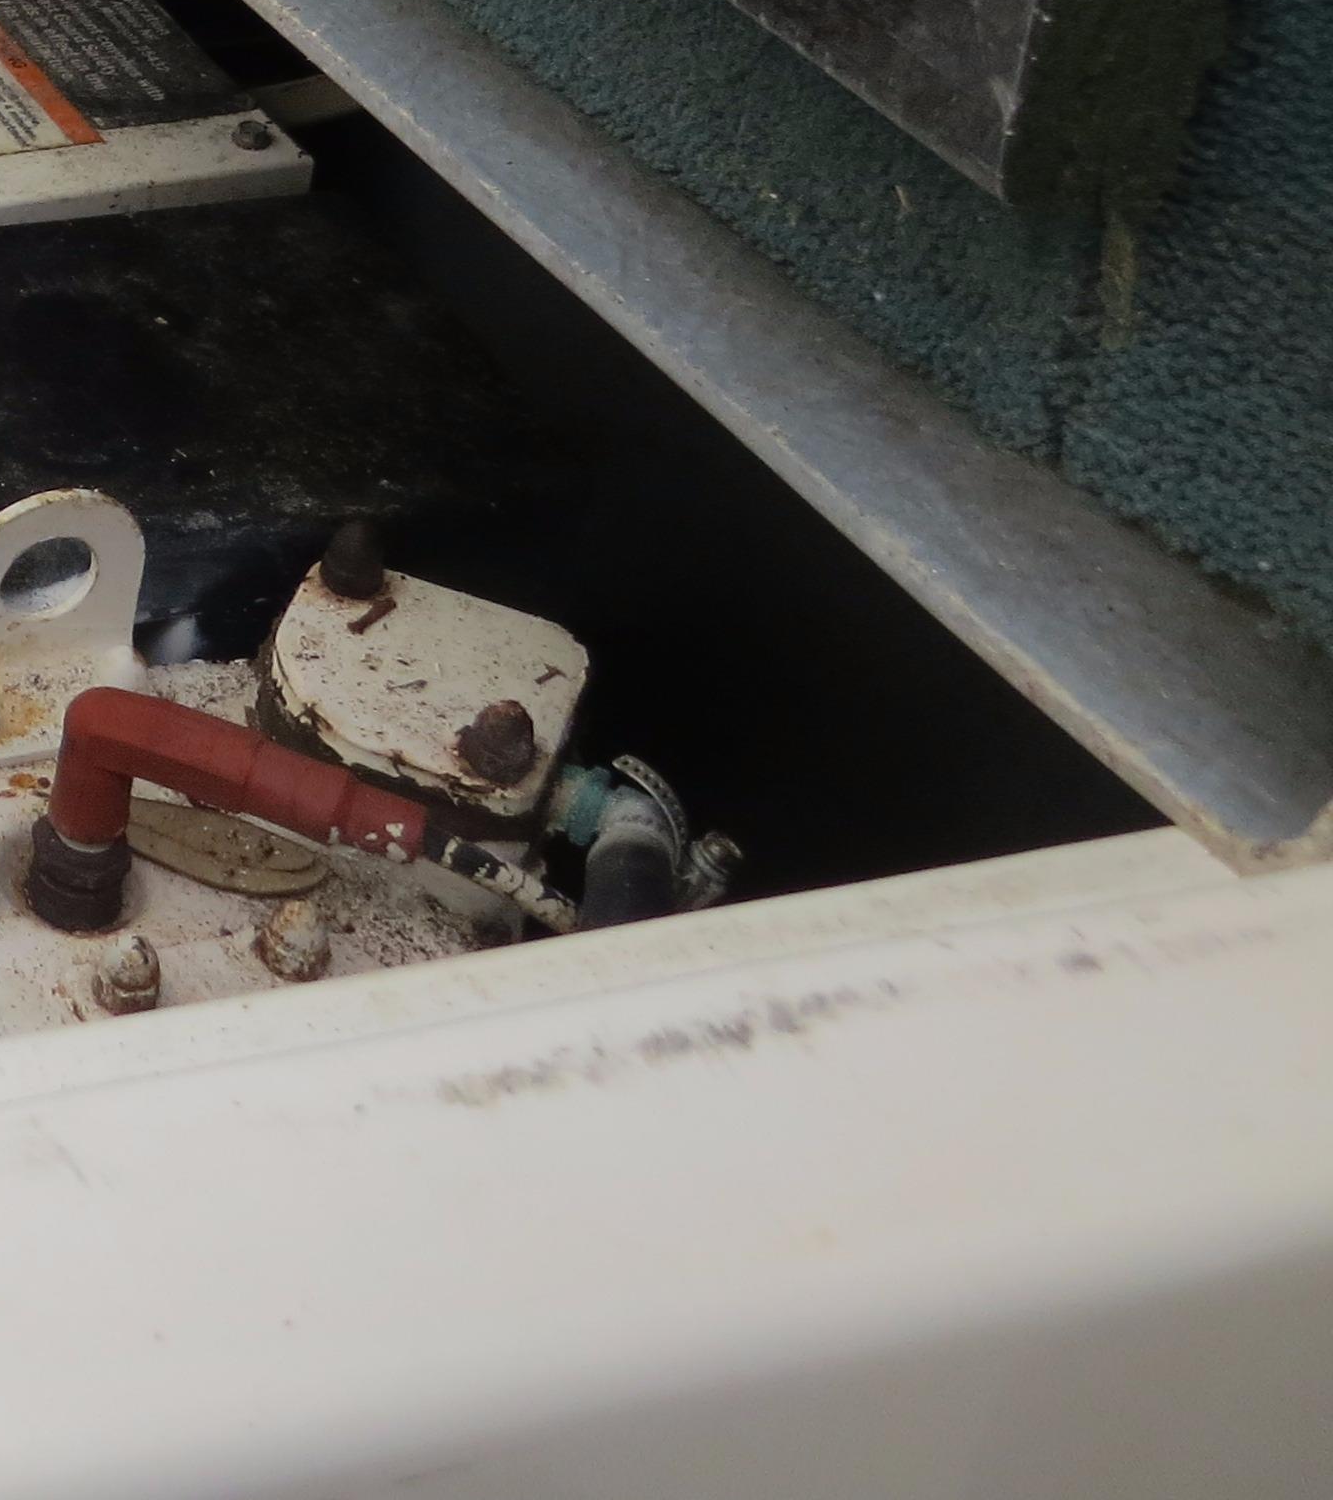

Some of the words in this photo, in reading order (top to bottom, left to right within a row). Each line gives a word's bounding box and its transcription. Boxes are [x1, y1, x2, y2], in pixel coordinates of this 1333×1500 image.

[40, 26, 81, 58] effect
[51, 12, 91, 43] Guard
[76, 42, 121, 77] Safety
[134, 77, 168, 102] with
